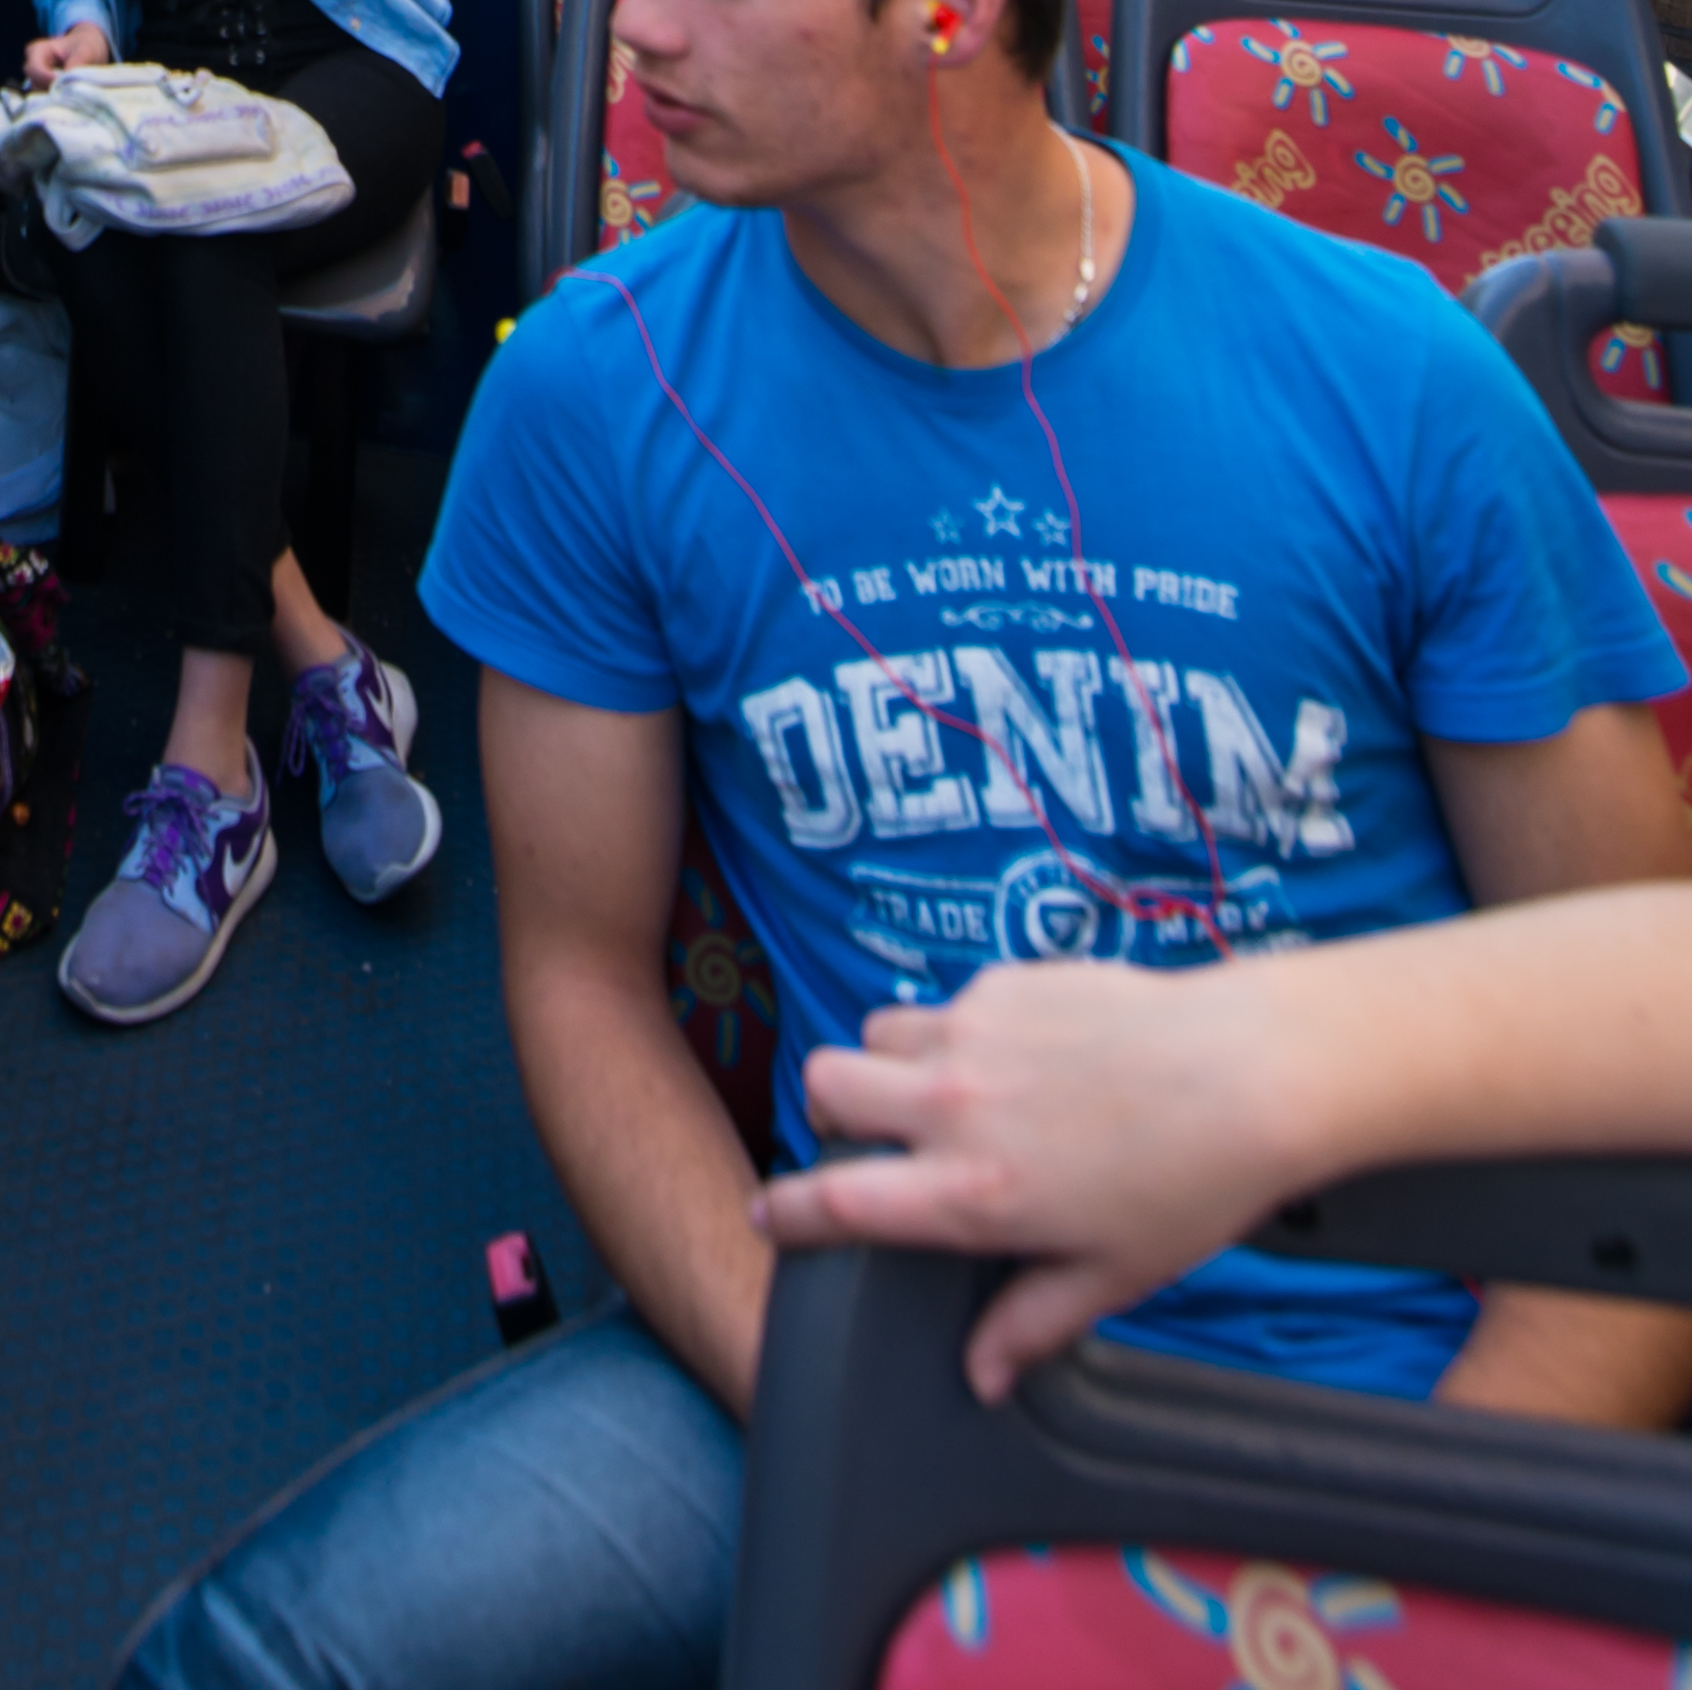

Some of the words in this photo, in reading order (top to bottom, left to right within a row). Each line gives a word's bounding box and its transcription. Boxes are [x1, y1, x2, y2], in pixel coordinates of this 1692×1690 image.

[801, 574, 844, 616] TO
[851, 565, 897, 606] BE
[904, 553, 1007, 597] WORN
[1020, 557, 1117, 598] WITH
[1132, 564, 1239, 621] PRIDE
[741, 645, 1356, 859] DENIM
[873, 888, 993, 944] TRADE
